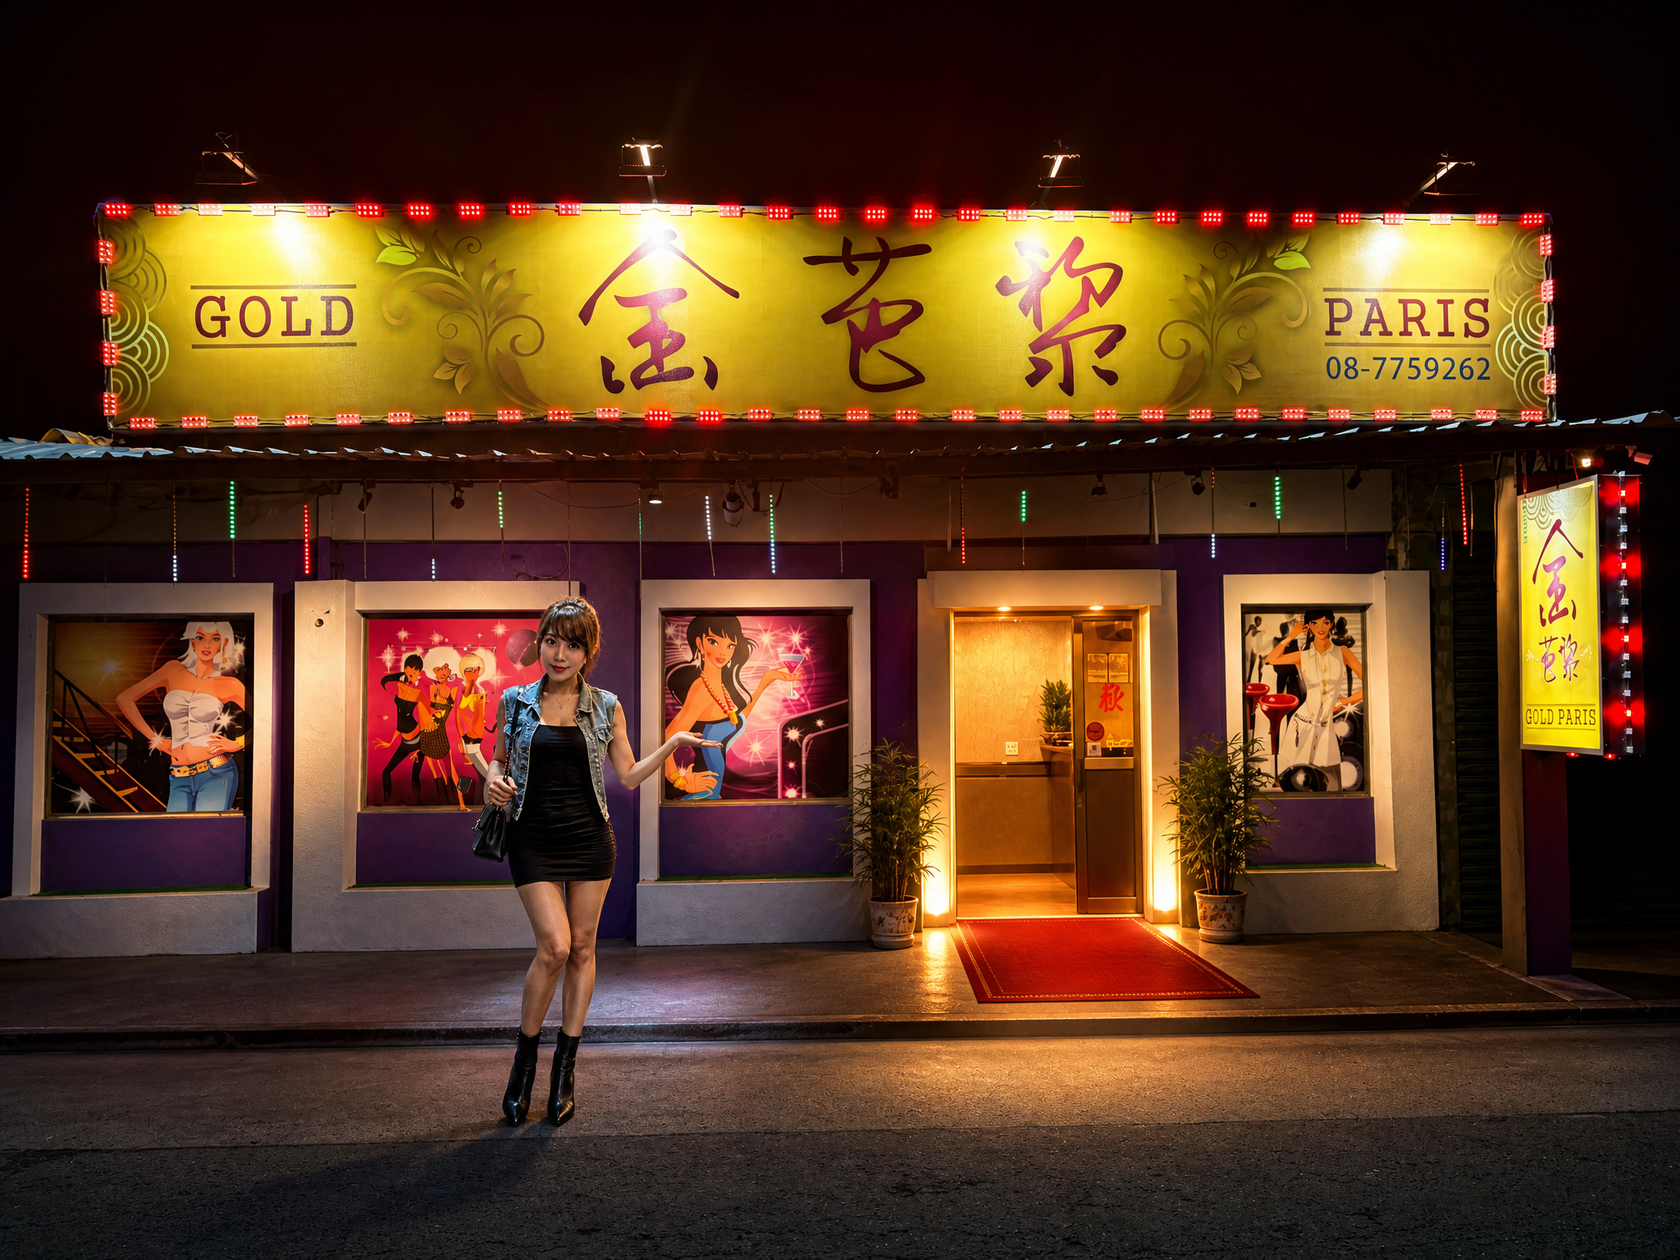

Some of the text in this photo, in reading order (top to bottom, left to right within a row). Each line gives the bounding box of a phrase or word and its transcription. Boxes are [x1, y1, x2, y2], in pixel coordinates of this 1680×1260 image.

[194, 295, 354, 339] GOLD
[1324, 297, 1490, 339] PARIS
[1326, 356, 1491, 381] 08-7759262
[1525, 708, 1597, 726] GOLD PARIS
